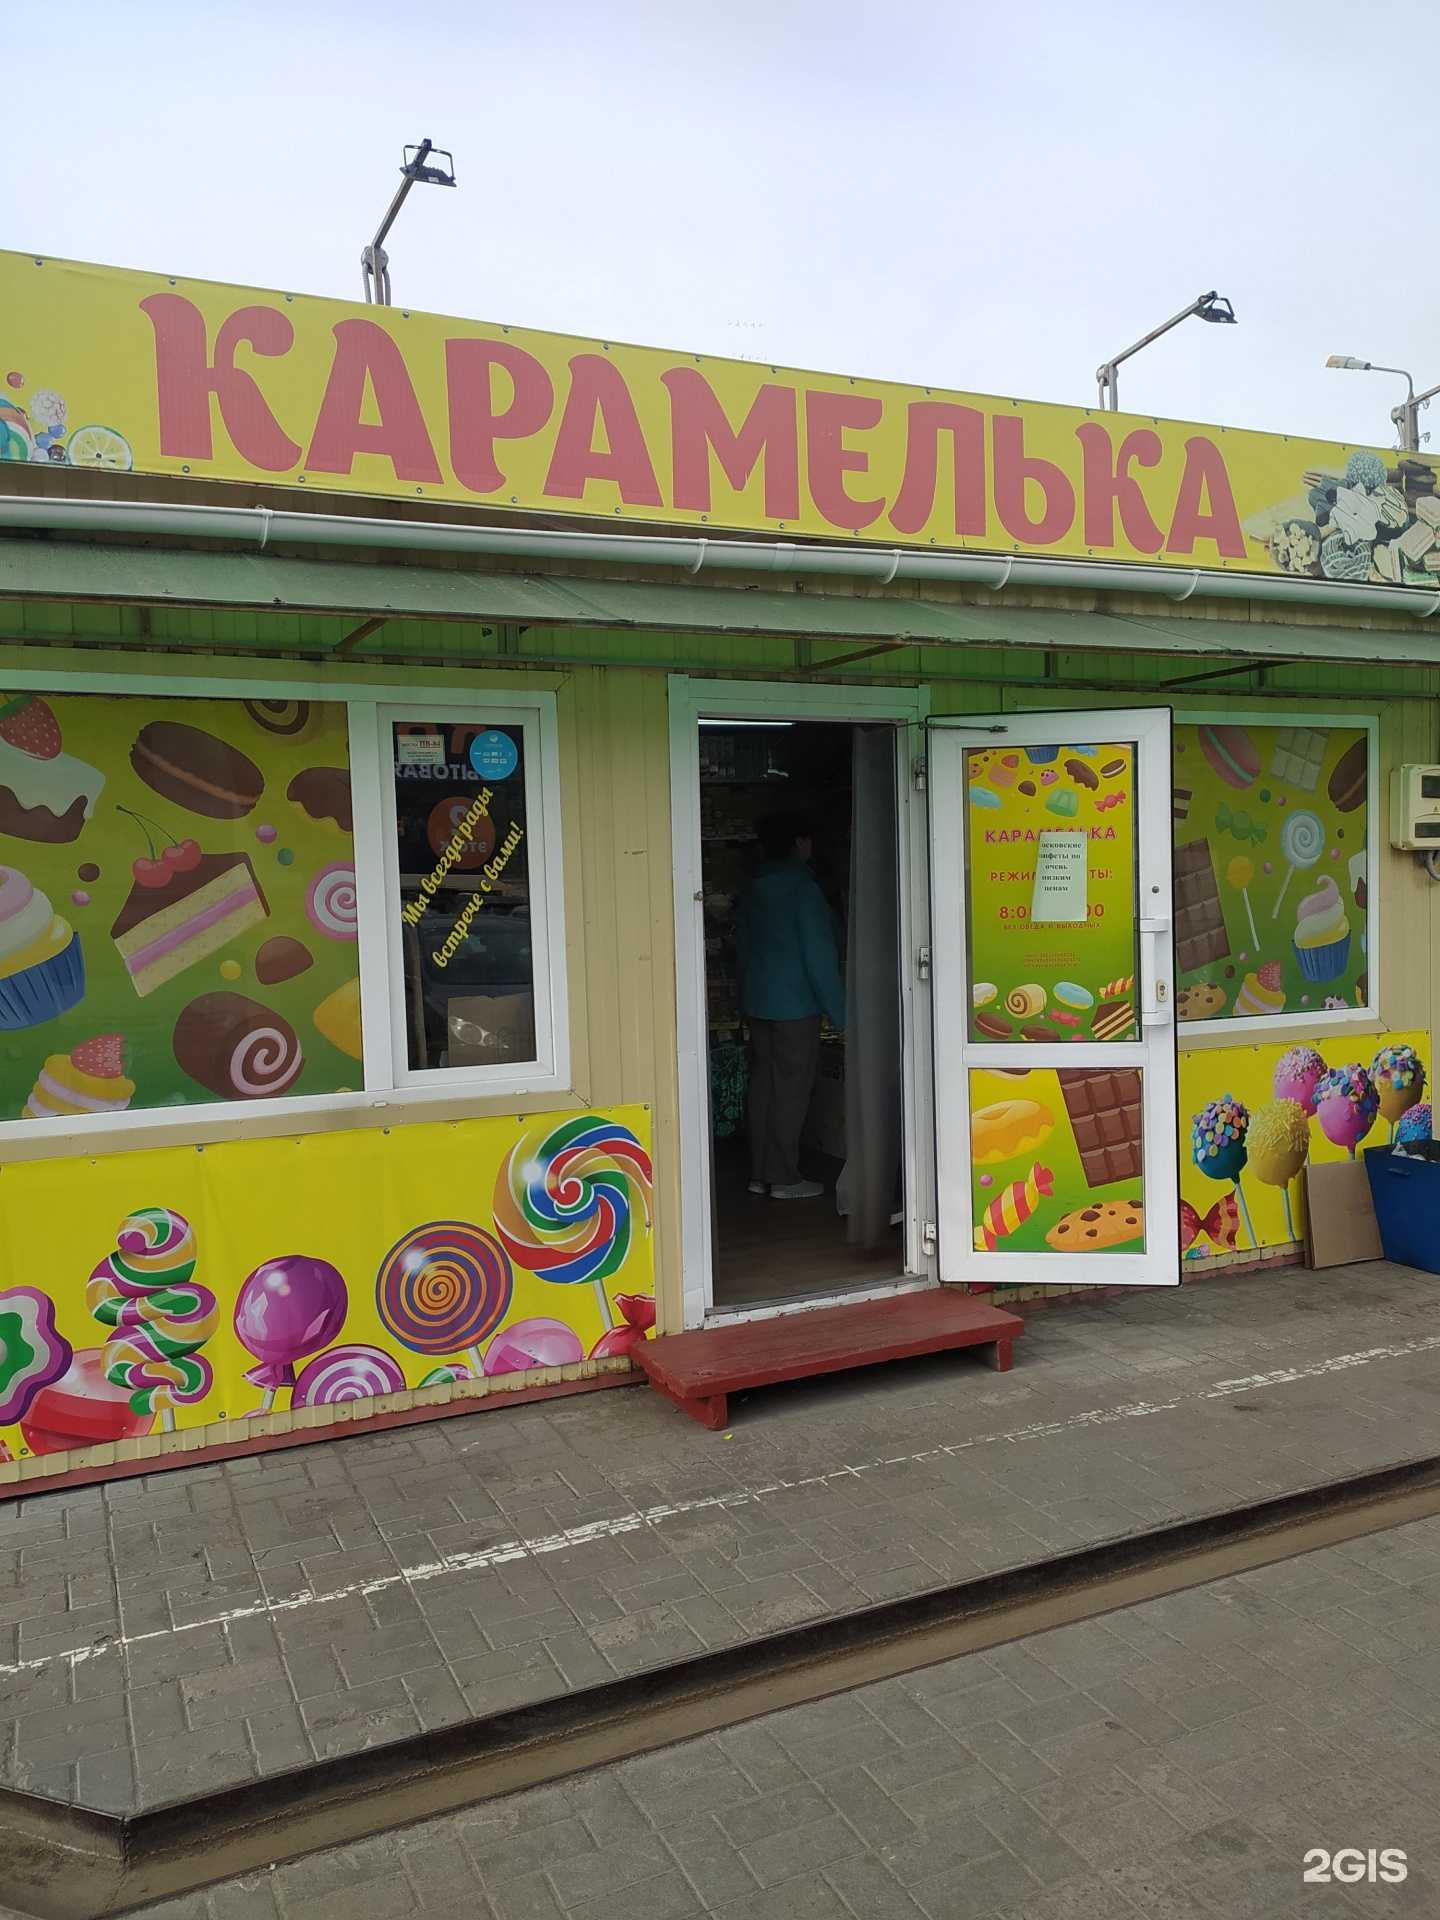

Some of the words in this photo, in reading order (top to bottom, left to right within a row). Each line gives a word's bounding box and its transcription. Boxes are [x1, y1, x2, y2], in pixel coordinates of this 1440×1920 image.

[139, 292, 1247, 560] КАРАМЕЛЬКА
[401, 894, 430, 927] Мы
[421, 835, 465, 894] всегда
[458, 786, 494, 841] рады
[483, 820, 524, 881] вами!
[985, 826, 1117, 843] КАРАКА
[480, 880, 492, 892] с
[432, 893, 484, 968] встрече
